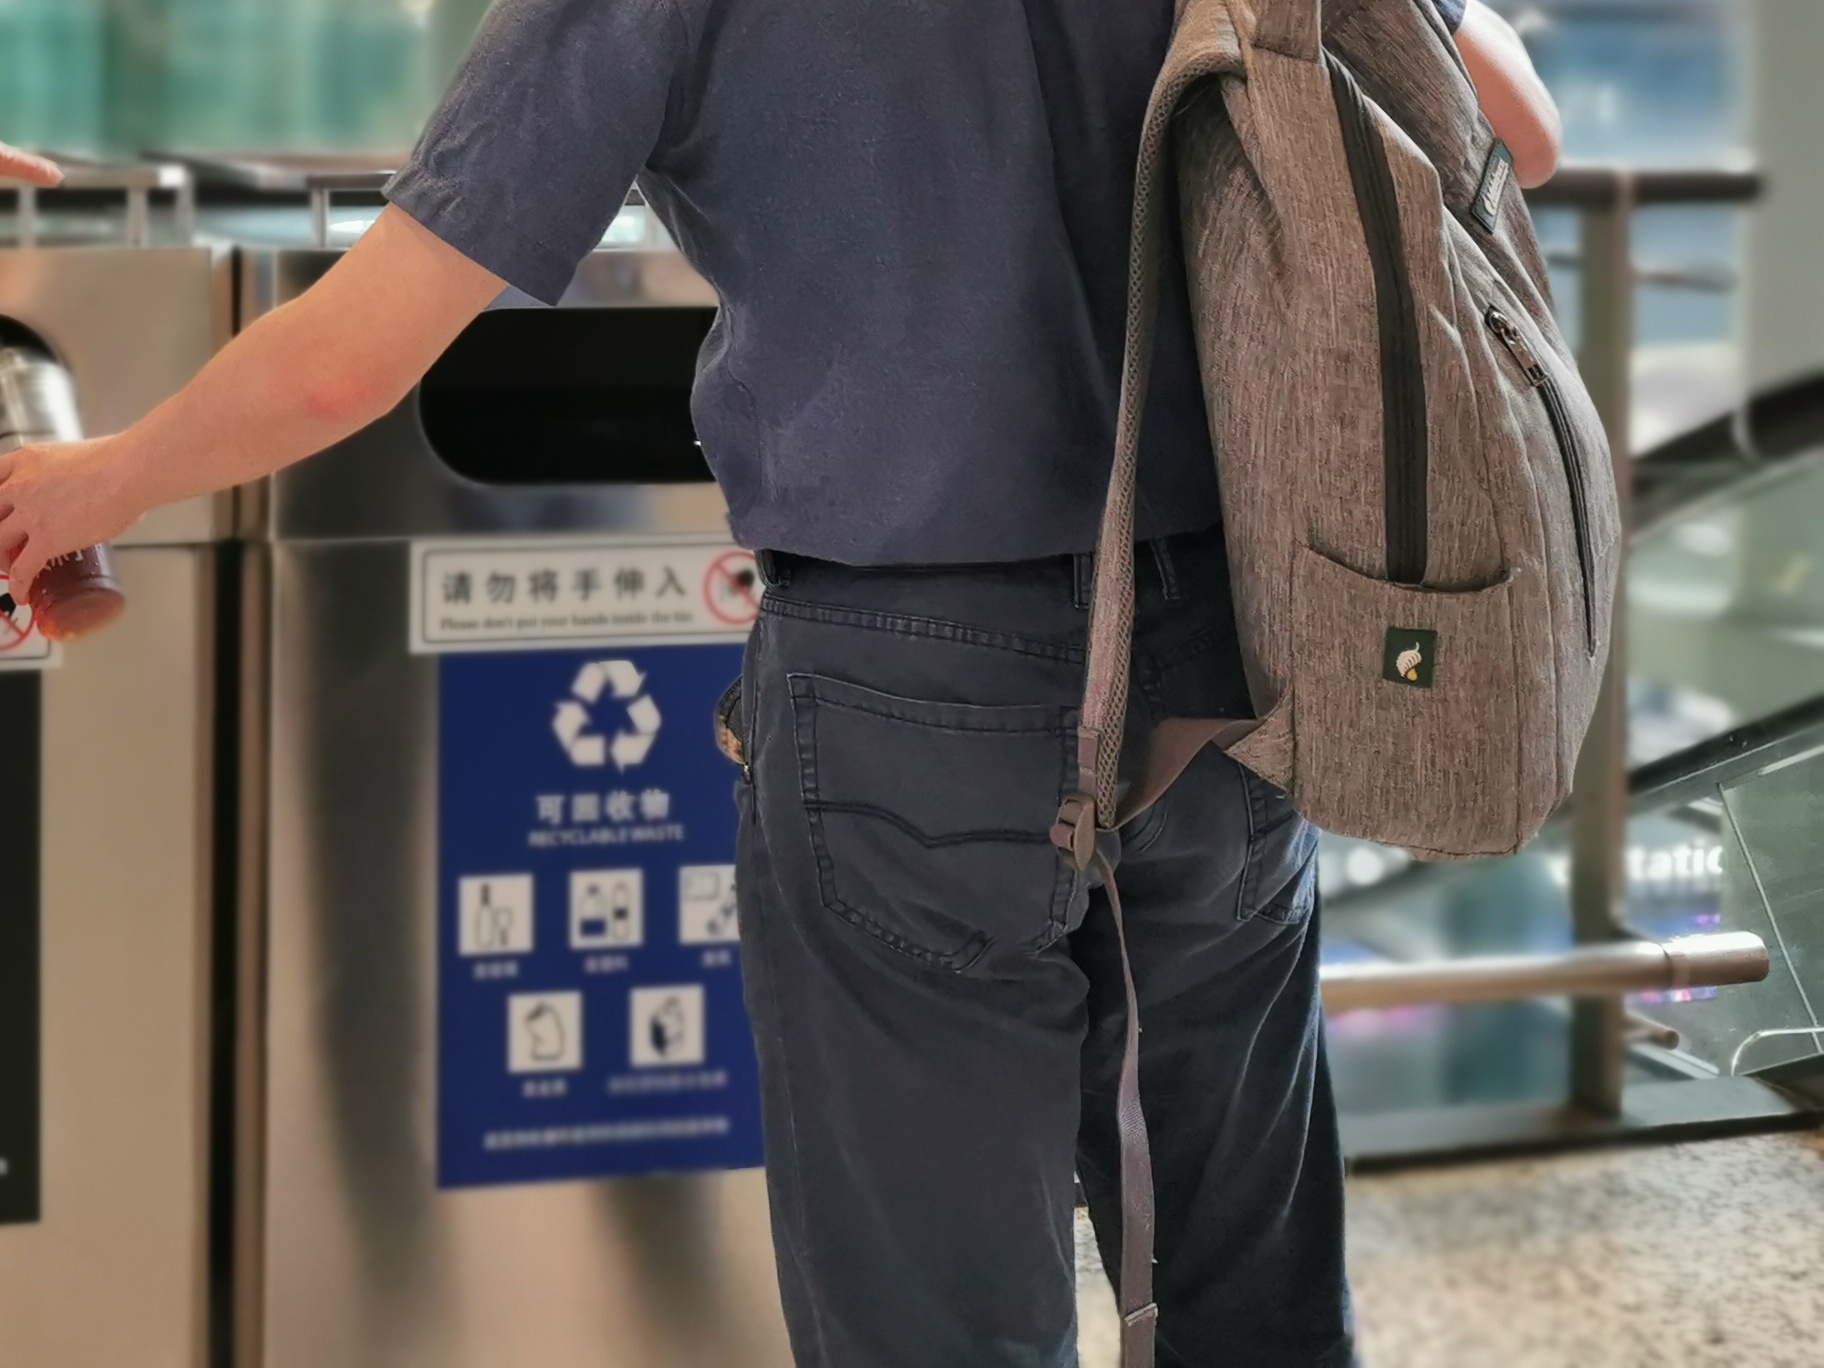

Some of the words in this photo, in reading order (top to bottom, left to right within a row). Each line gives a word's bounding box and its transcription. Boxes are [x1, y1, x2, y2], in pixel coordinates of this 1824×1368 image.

[441, 566, 686, 605] 请勿将手伸入
[535, 788, 670, 825] 可回收物
